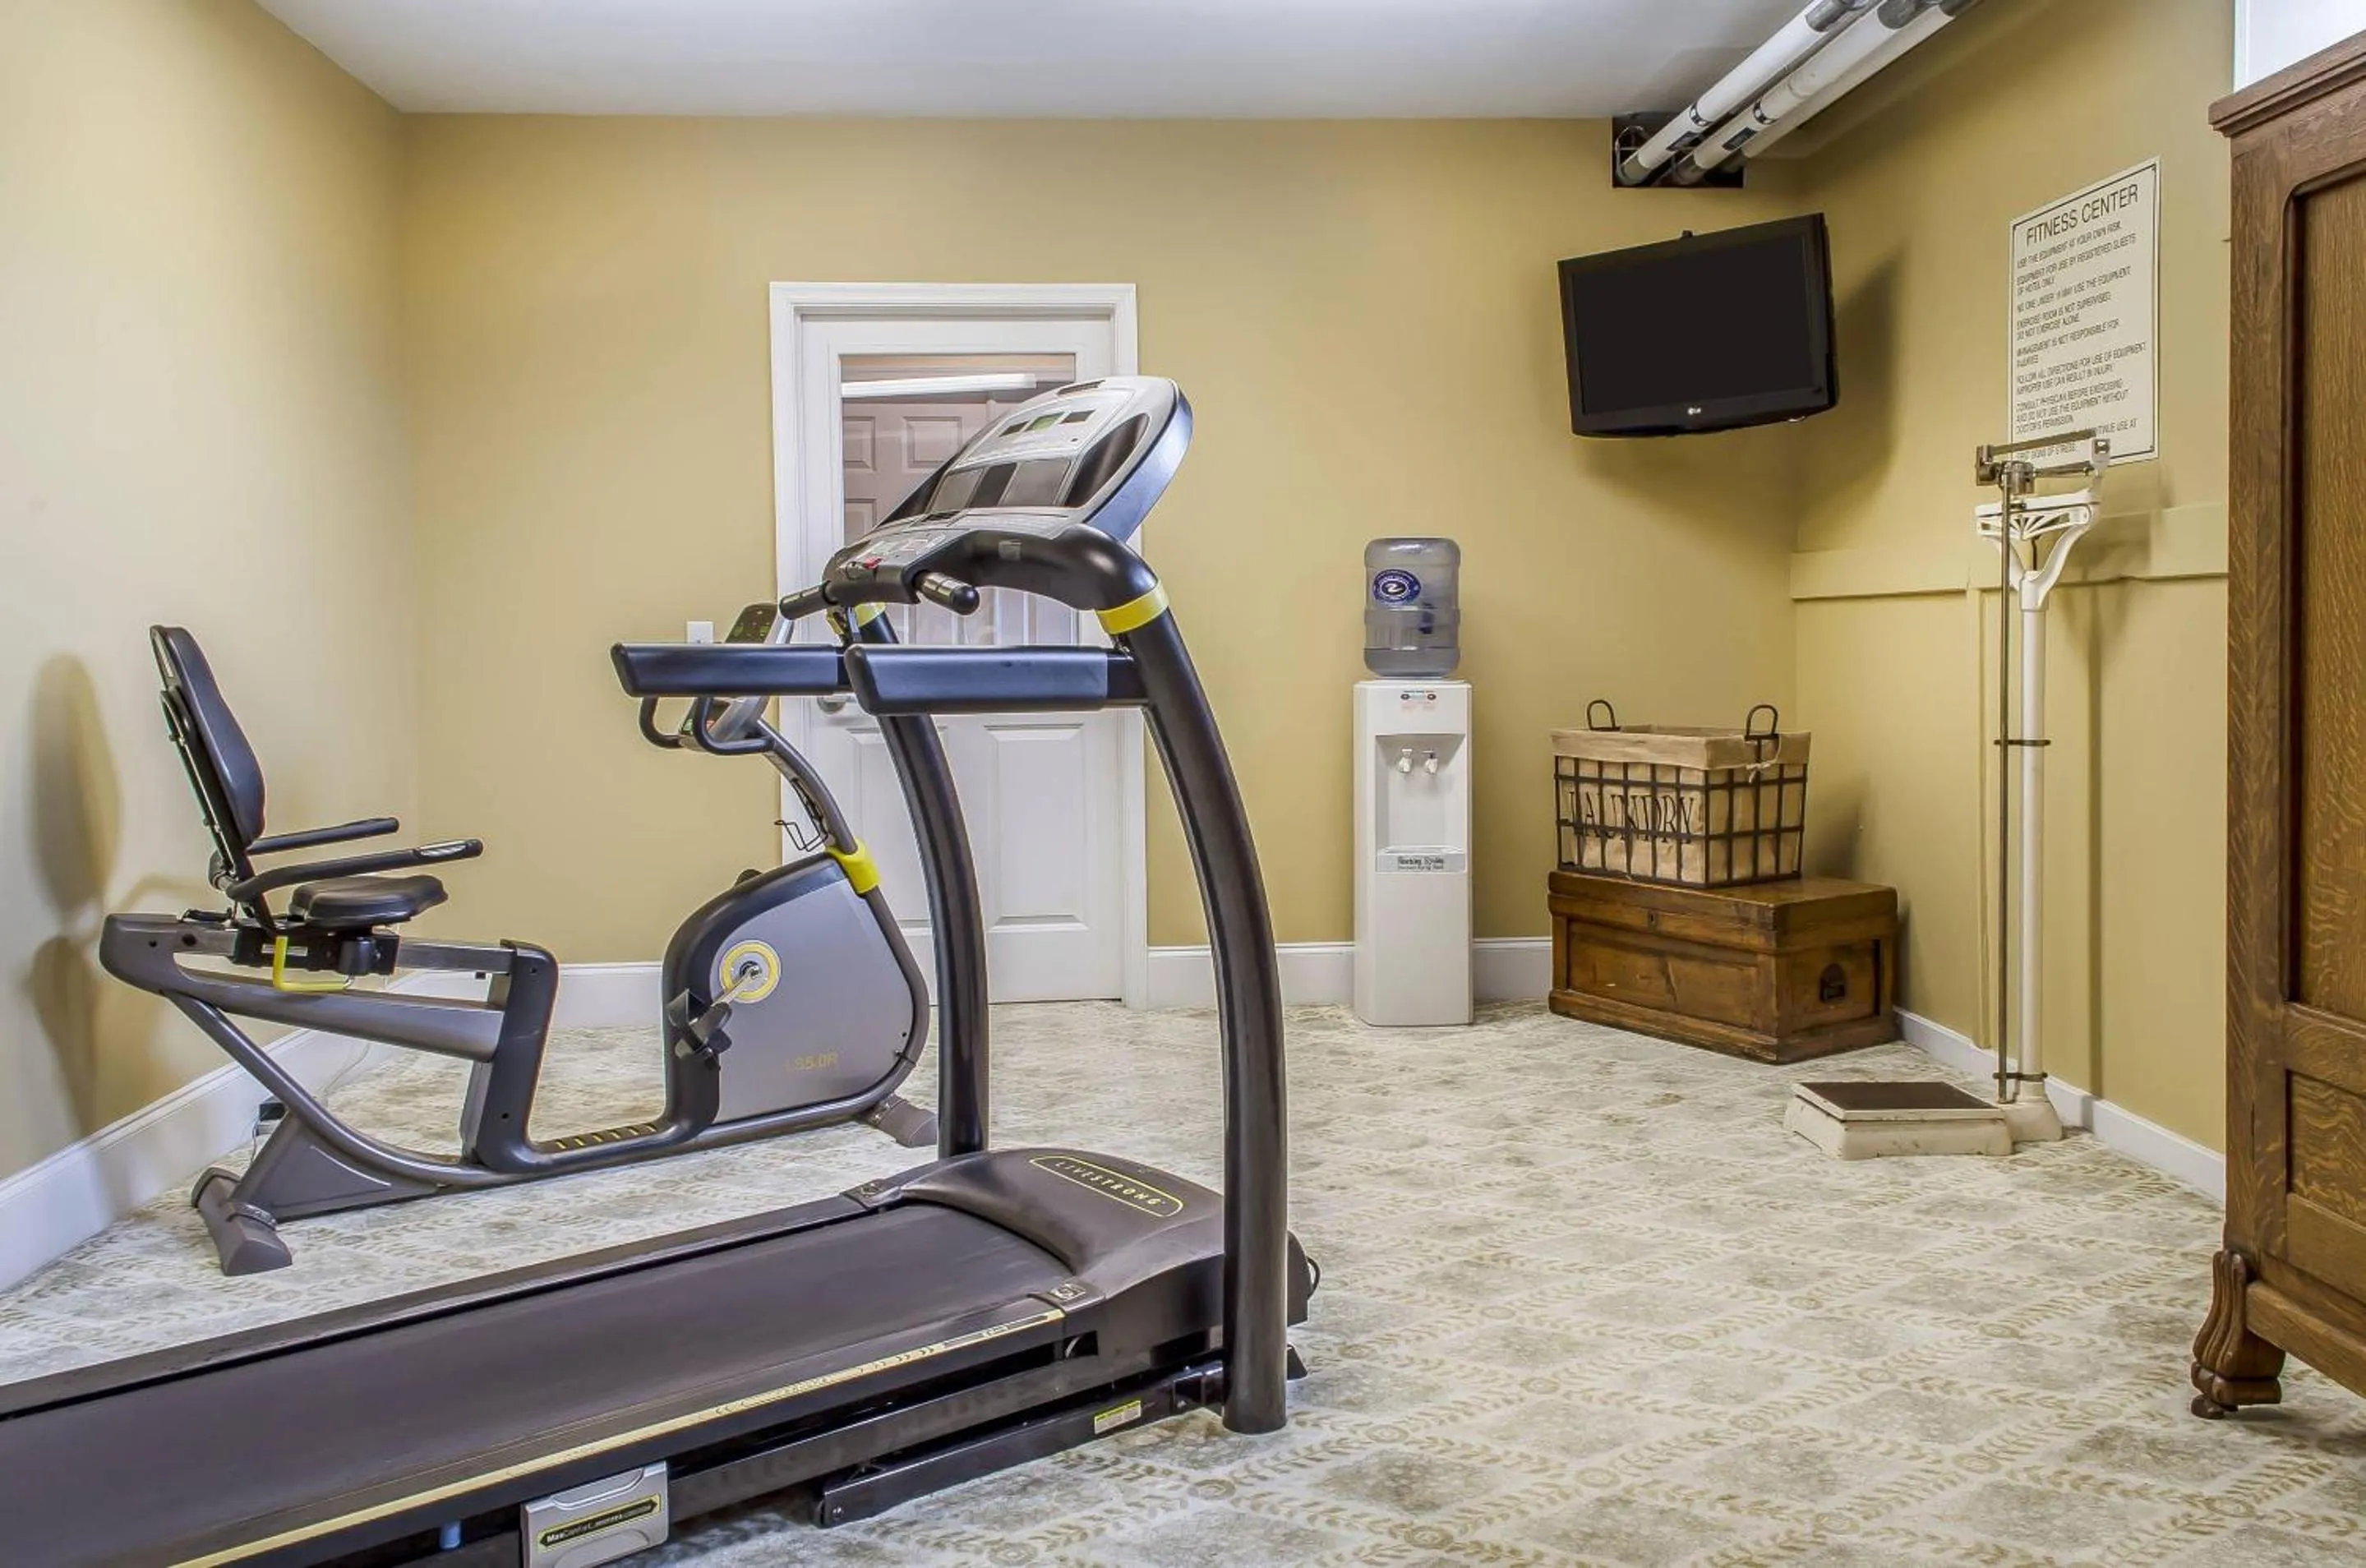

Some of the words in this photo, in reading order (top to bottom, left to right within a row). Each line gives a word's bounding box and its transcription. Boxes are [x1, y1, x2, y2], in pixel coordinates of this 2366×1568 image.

[2026, 206, 2078, 247] FITNESS
[2081, 181, 2138, 225] CENTER
[2017, 265, 2045, 287] EQUIPMENT
[2045, 261, 2057, 276] FOR
[2058, 257, 2068, 271] USE
[2069, 254, 2076, 267] BY
[2077, 240, 2111, 265] REGISTERED
[2112, 231, 2136, 251] GUESTS
[2038, 240, 2068, 261] EQUIPMENT
[2076, 230, 2092, 247] YOUR
[2092, 224, 2105, 241] OWN
[2024, 297, 2036, 311] ONE
[2036, 291, 2054, 307] UNDER
[2073, 280, 2085, 295] USE
[2085, 276, 2097, 291] THE
[2016, 311, 2041, 330] EXERCISE
[2042, 307, 2057, 322] ROOM
[2058, 305, 2063, 317] IS
[2064, 301, 2076, 315] NOT
[2024, 325, 2035, 339] NOT
[2035, 317, 2061, 335] EXERCISE
[2016, 338, 2050, 357] MANAGEMENT
[2051, 335, 2057, 348] IS
[2058, 332, 2069, 345] NOT
[2069, 321, 2107, 342] RESPONSIBLE
[2106, 316, 2119, 331] FOR
[2016, 370, 2036, 385] FOLLOW
[2047, 358, 2078, 377] DIRECTIONS
[2078, 355, 2091, 369] FOR
[2091, 352, 2102, 366] USE
[2103, 349, 2111, 362] OF
[2016, 380, 2041, 397] IMPROPER
[2041, 377, 2053, 390] USE
[2055, 374, 2065, 387] CAN
[2065, 368, 2085, 384] RESULT
[2015, 398, 2040, 413] CONSULT
[2039, 390, 2067, 408] PHYSICIAN
[2067, 385, 2088, 401] BEFORE
[2089, 376, 2123, 395] EXERCISING
[2047, 405, 2058, 417] USE
[2058, 402, 2069, 415] THE
[2070, 394, 2101, 413] EQUIPMENT
[2116, 418, 2128, 432] USE
[2129, 417, 2138, 430] AT
[1054, 1161, 1161, 1205] LIVESTRONG
